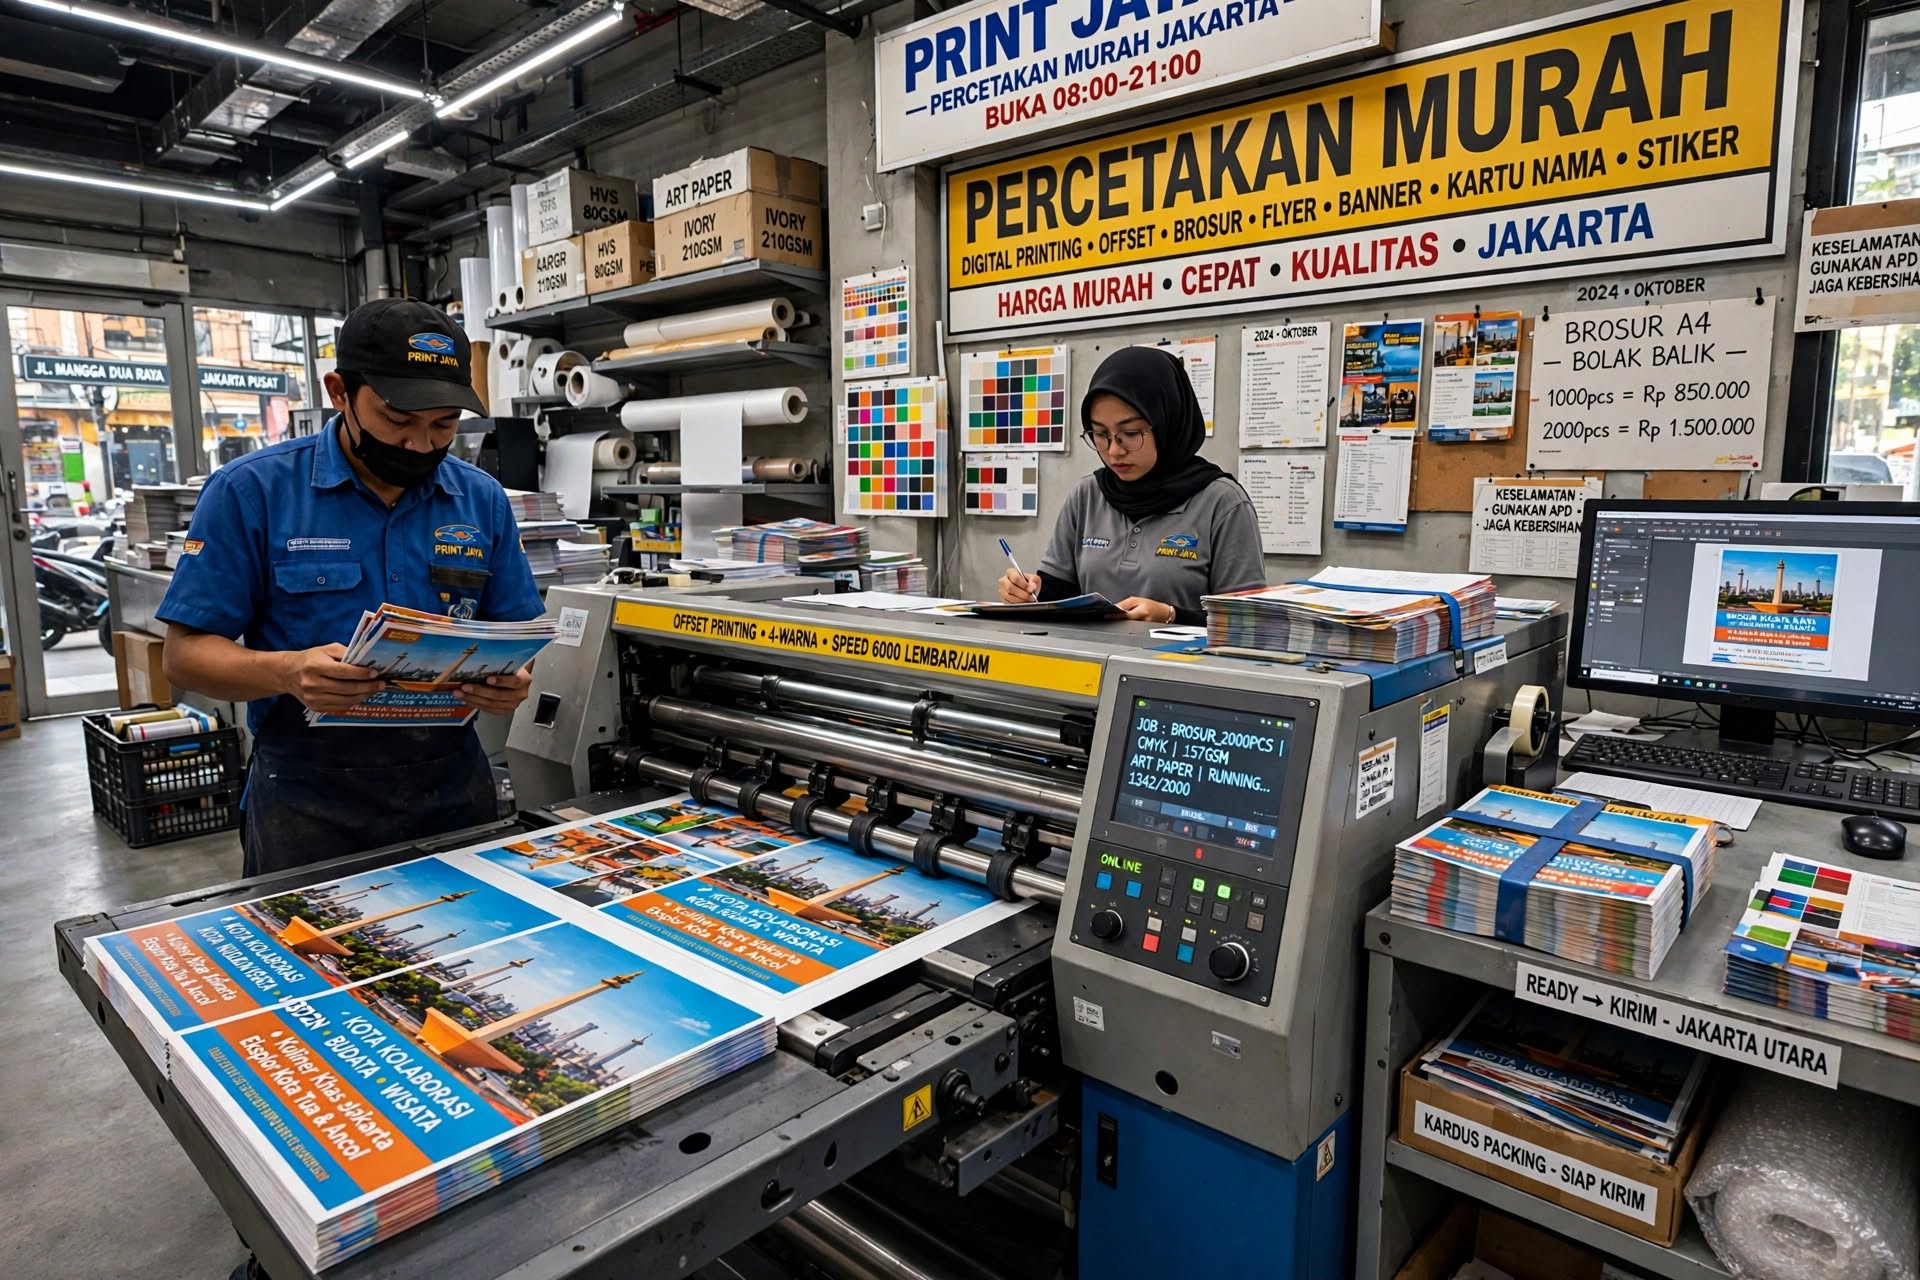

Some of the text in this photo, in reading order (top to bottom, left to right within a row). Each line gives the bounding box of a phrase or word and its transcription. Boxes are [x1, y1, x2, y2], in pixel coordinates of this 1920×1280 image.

[905, 0, 1198, 93] PRINT JA
[930, 0, 1279, 115] PERCETAKAN MURAH JAKARTA
[985, 49, 1201, 130] BUKA 08:00-21:00
[966, 9, 1733, 244] PERCETAKAN MURAH
[590, 186, 619, 205] HVS
[665, 169, 733, 209] ART PAPER
[962, 125, 1740, 276] DIGITAL PRINTING OFFSET BROSUR FLYER BANNER KARTU NAMA STIKER
[583, 205, 628, 223] 80GSM
[684, 213, 716, 238] IVORY
[766, 207, 807, 232] IVORY
[598, 239, 616, 258] HVS
[682, 236, 722, 262] 210GSM
[761, 230, 813, 257] 210GSM
[1811, 231, 1920, 257] KESELAMATAN
[594, 258, 623, 279] 80GSM
[998, 202, 1654, 318] HARGA MURAH CEPAT KUALITAS JAKARTA
[1810, 252, 1918, 275] GUNAKAN APD
[1577, 277, 1705, 301] 2024 OKTOBER
[1809, 277, 1843, 294] JAGA
[1254, 326, 1318, 341] 2024 OKTOBER
[1565, 311, 1712, 344] BROSUR A4
[407, 351, 459, 368] PRINT JAYA
[1572, 343, 1715, 372] BOLAK BALIK
[34, 361, 165, 383] JL. MANGGA DUA RAYA
[201, 371, 279, 390] JAKARTA PUSAT
[1547, 387, 1614, 410] 1000pcs
[1643, 385, 1666, 408] Rp
[1674, 380, 1750, 402] 850.000
[1543, 421, 1610, 444] 2000pcs
[1638, 419, 1661, 443] Rp
[1669, 417, 1755, 438] 1.500.000
[1495, 488, 1576, 501] KESELAMATAN
[1492, 503, 1573, 517] GUNAKAN APD
[1483, 519, 1582, 533] JAGA KEBERSIHAN
[434, 544, 464, 555] PRINT
[673, 613, 990, 674] OFFSET PRINTING 4-WARNA SPEED 6000 LEMBAR/JAM
[1137, 735, 1169, 754] CMYK
[1182, 744, 1230, 766] 157GSM
[1170, 722, 1274, 753] BROSUR_2000PCS
[1130, 753, 1154, 770] ART
[1156, 758, 1193, 779] PAPER
[1128, 772, 1191, 797] 1342/2000
[1100, 853, 1144, 875] ONLINE
[750, 908, 844, 949] KOLABORASI
[772, 931, 826, 956] WISATA
[1526, 973, 1579, 1004] READY
[1609, 995, 1657, 1027] KIRIM
[1676, 1014, 1758, 1056] JAKARTA
[1763, 1036, 1828, 1076] UTARA
[341, 1015, 388, 1048] KOTA
[377, 1044, 475, 1120] KOLABORASI
[239, 1034, 281, 1072] Eksplor
[270, 1067, 303, 1097] Kota
[294, 1091, 321, 1117] Tua
[321, 1123, 373, 1161] Ancol
[309, 1071, 347, 1103] Khas
[324, 1035, 381, 1079] BUDATA
[380, 1082, 443, 1134] WISATA
[1424, 1112, 1480, 1148] KARDUS
[1483, 1135, 1547, 1175] PACKING
[1561, 1164, 1597, 1192] SIAP
[1600, 1178, 1647, 1212] KIRIM
